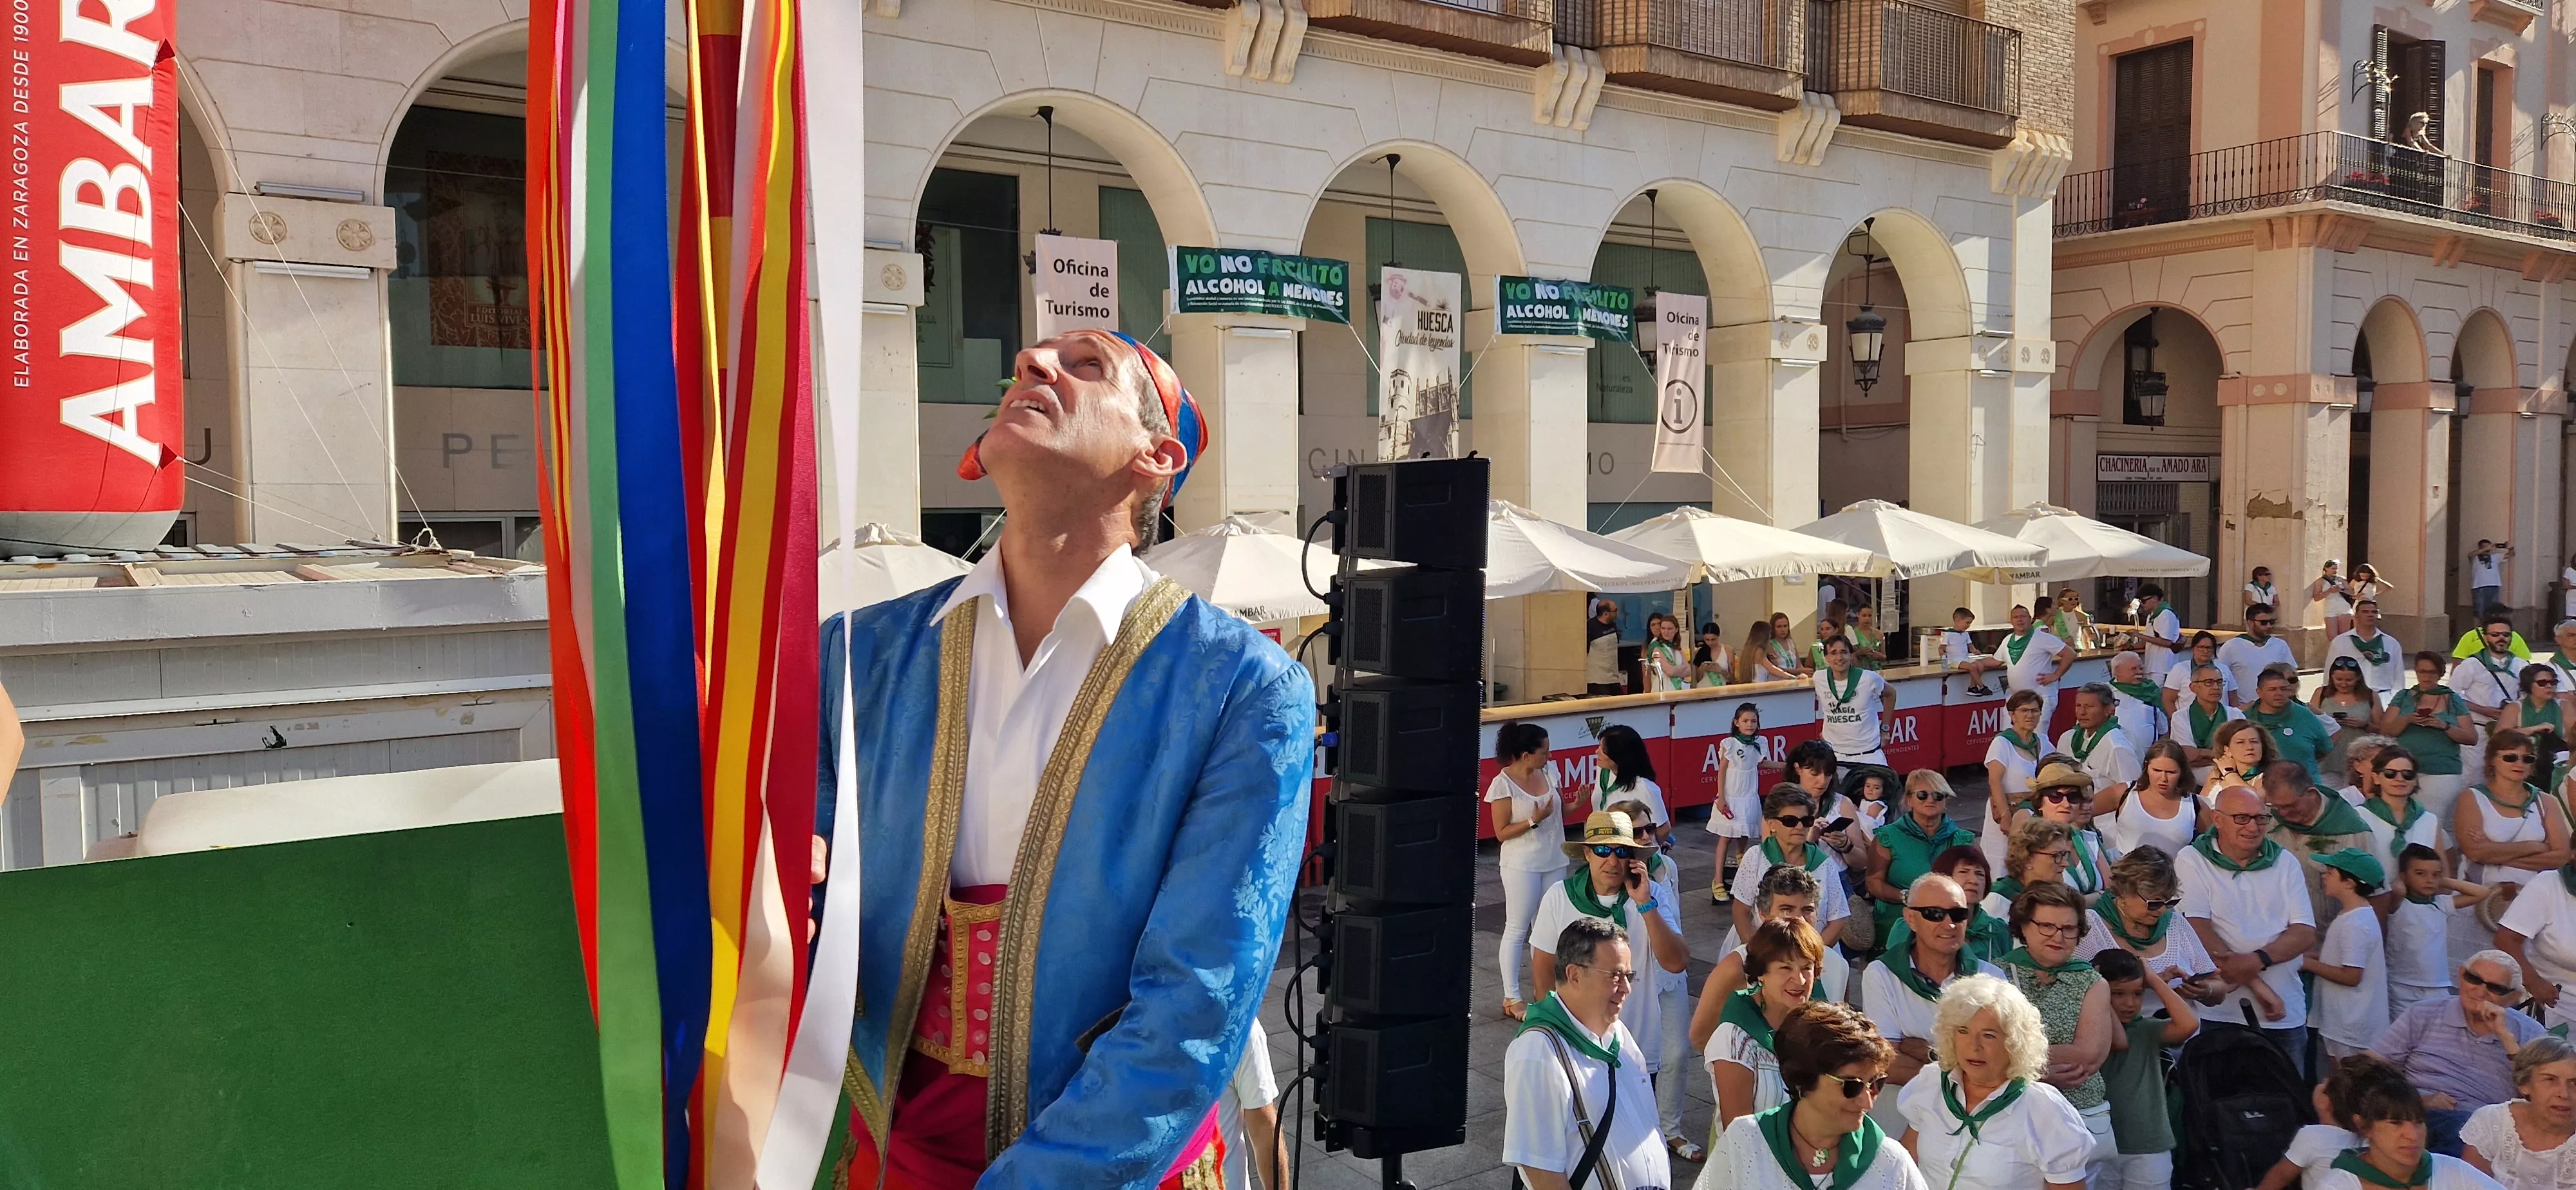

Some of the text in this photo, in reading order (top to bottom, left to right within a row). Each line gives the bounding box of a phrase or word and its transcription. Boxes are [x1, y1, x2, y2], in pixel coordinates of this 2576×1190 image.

[14, 0, 30, 388] ELABORADA EN ZARAGOZA DESDE 1900
[59, 0, 160, 469] AMBAR
[1053, 258, 1109, 278] Oficina
[1185, 254, 1343, 286] YO NO FACILITO
[1089, 282, 1110, 298] de
[1186, 278, 1265, 296] ALCOHOL
[1268, 281, 1280, 296] A
[1283, 283, 1343, 307] MENORES
[1506, 282, 1531, 300] YO
[1535, 283, 1559, 300] NO
[1045, 299, 1110, 318] Turismo
[1506, 304, 1569, 319] ALCOHOL
[1574, 307, 1582, 319] A
[1583, 308, 1629, 328] MENORES
[471, 314, 529, 325] LUIS VIVES
[1417, 310, 1454, 333] HUESCA
[1395, 329, 1455, 352] Ciudad de leyendas
[1688, 329, 1700, 342] de
[2099, 457, 2147, 473] CHACINERIA
[2161, 458, 2188, 473] AMADO
[2191, 459, 2207, 473] ARA
